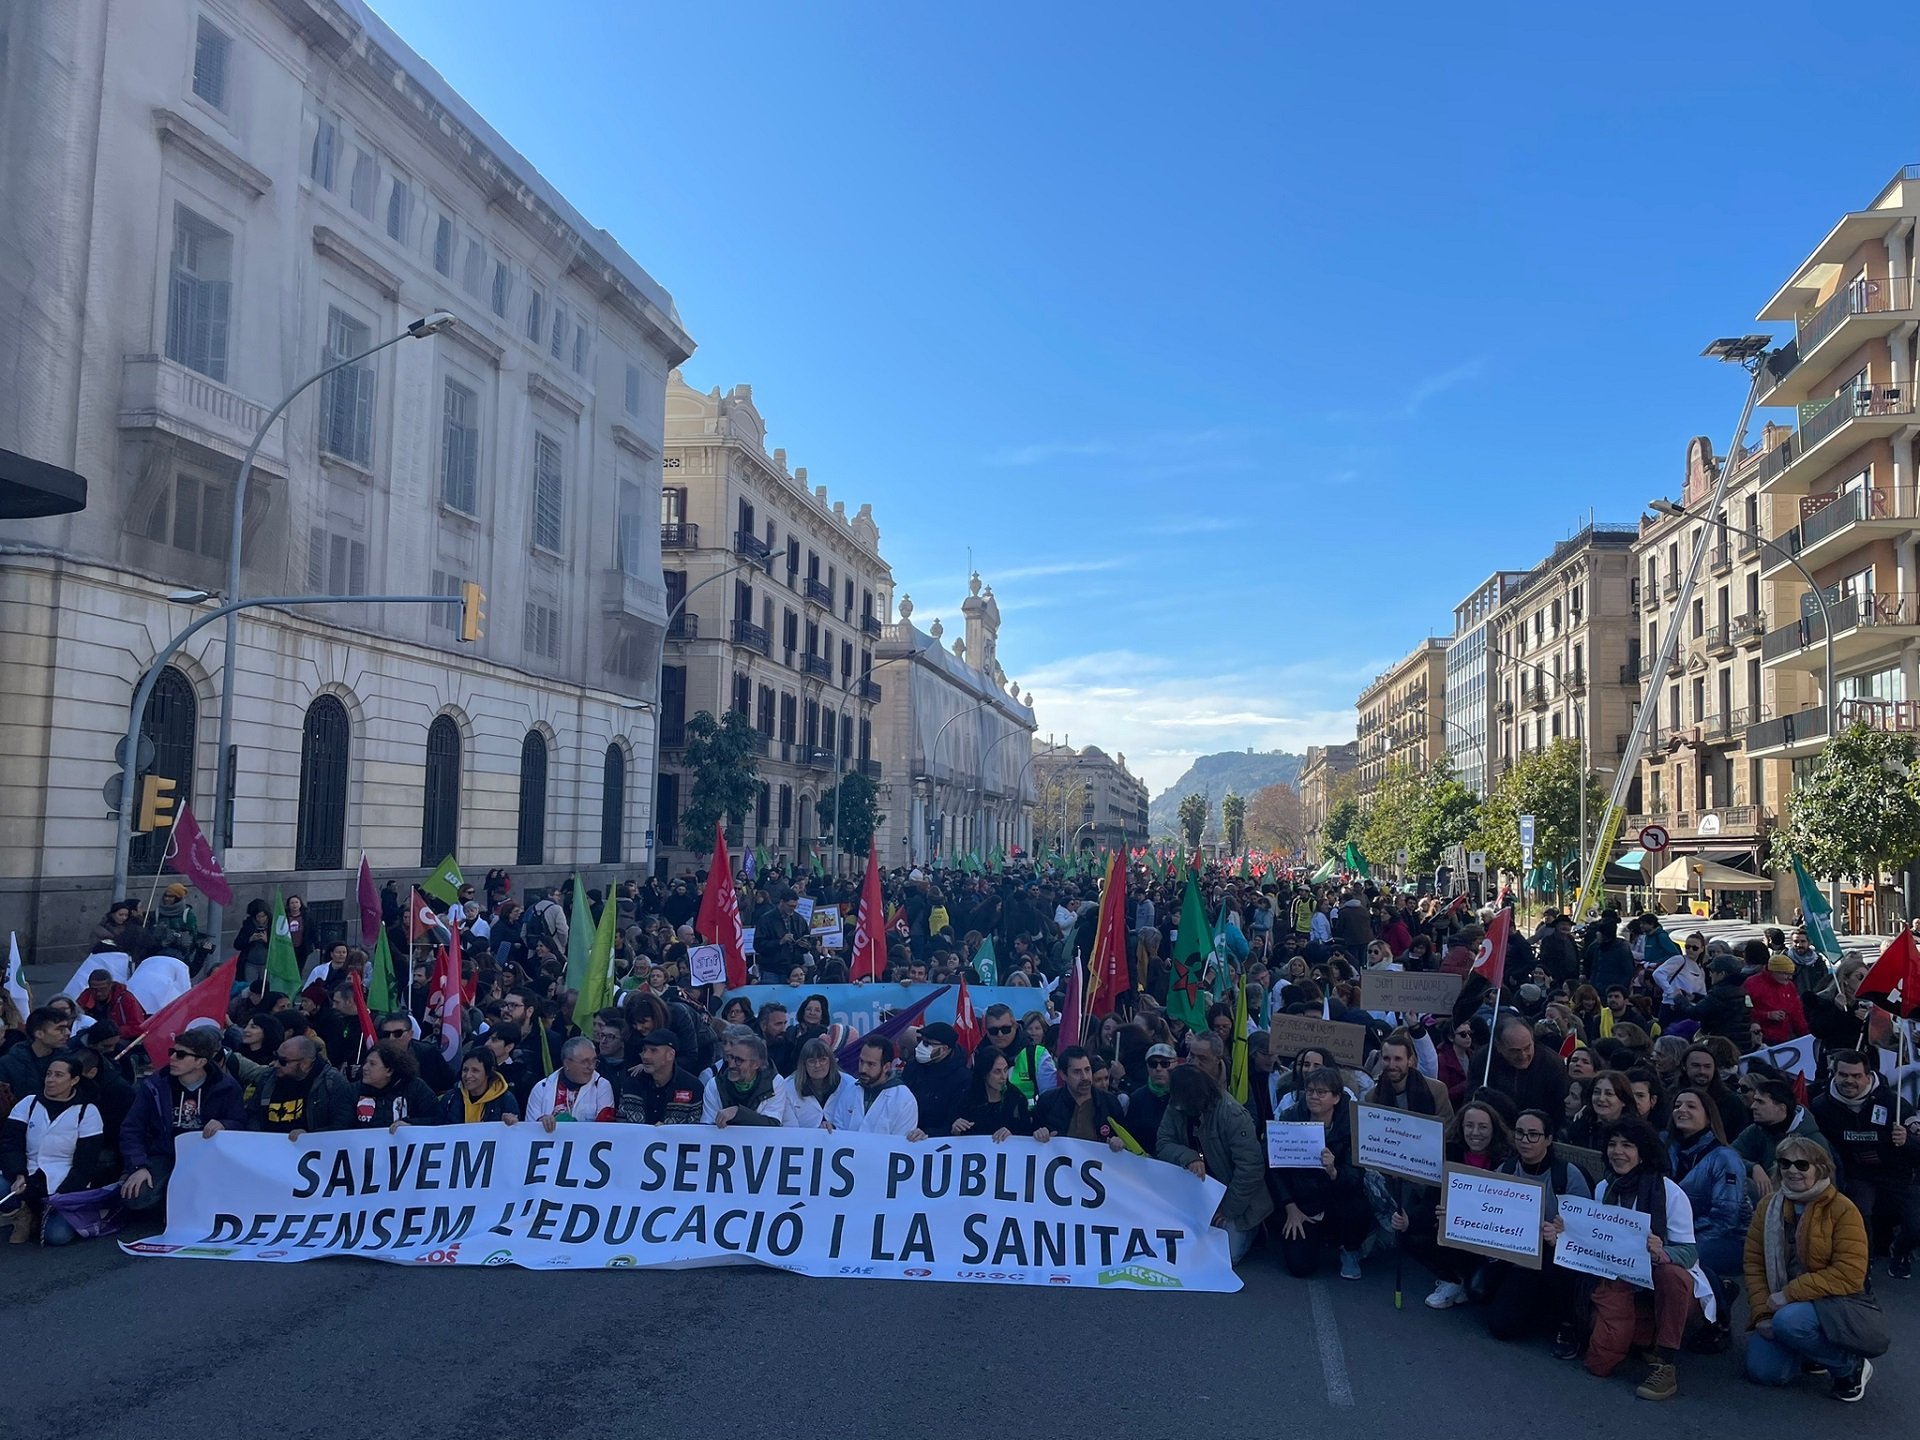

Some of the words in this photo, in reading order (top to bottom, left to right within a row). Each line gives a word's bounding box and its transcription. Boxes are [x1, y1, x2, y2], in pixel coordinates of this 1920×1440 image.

[1410, 1157, 1437, 1167] qualitat
[293, 1139, 496, 1198] SALVEM
[524, 1140, 612, 1190] ELS
[640, 1141, 855, 1198] SERVEIS
[886, 1143, 1106, 1209] PÚBLICS
[1451, 1179, 1472, 1191] Som
[1477, 1184, 1533, 1202] Llevadores,
[1481, 1202, 1504, 1214] Som
[1561, 1201, 1583, 1214] Som
[1587, 1207, 1642, 1231] Llevadores,
[198, 1205, 476, 1250] DEFENSEM
[487, 1198, 806, 1257] L'EDUCACIÓ
[829, 1214, 845, 1258] I
[870, 1212, 935, 1262] LA
[962, 1213, 1184, 1267] SANITAT
[1454, 1216, 1524, 1237] Especialistes!!
[1592, 1228, 1614, 1242] Som
[1565, 1241, 1636, 1268] Especialistes!!
